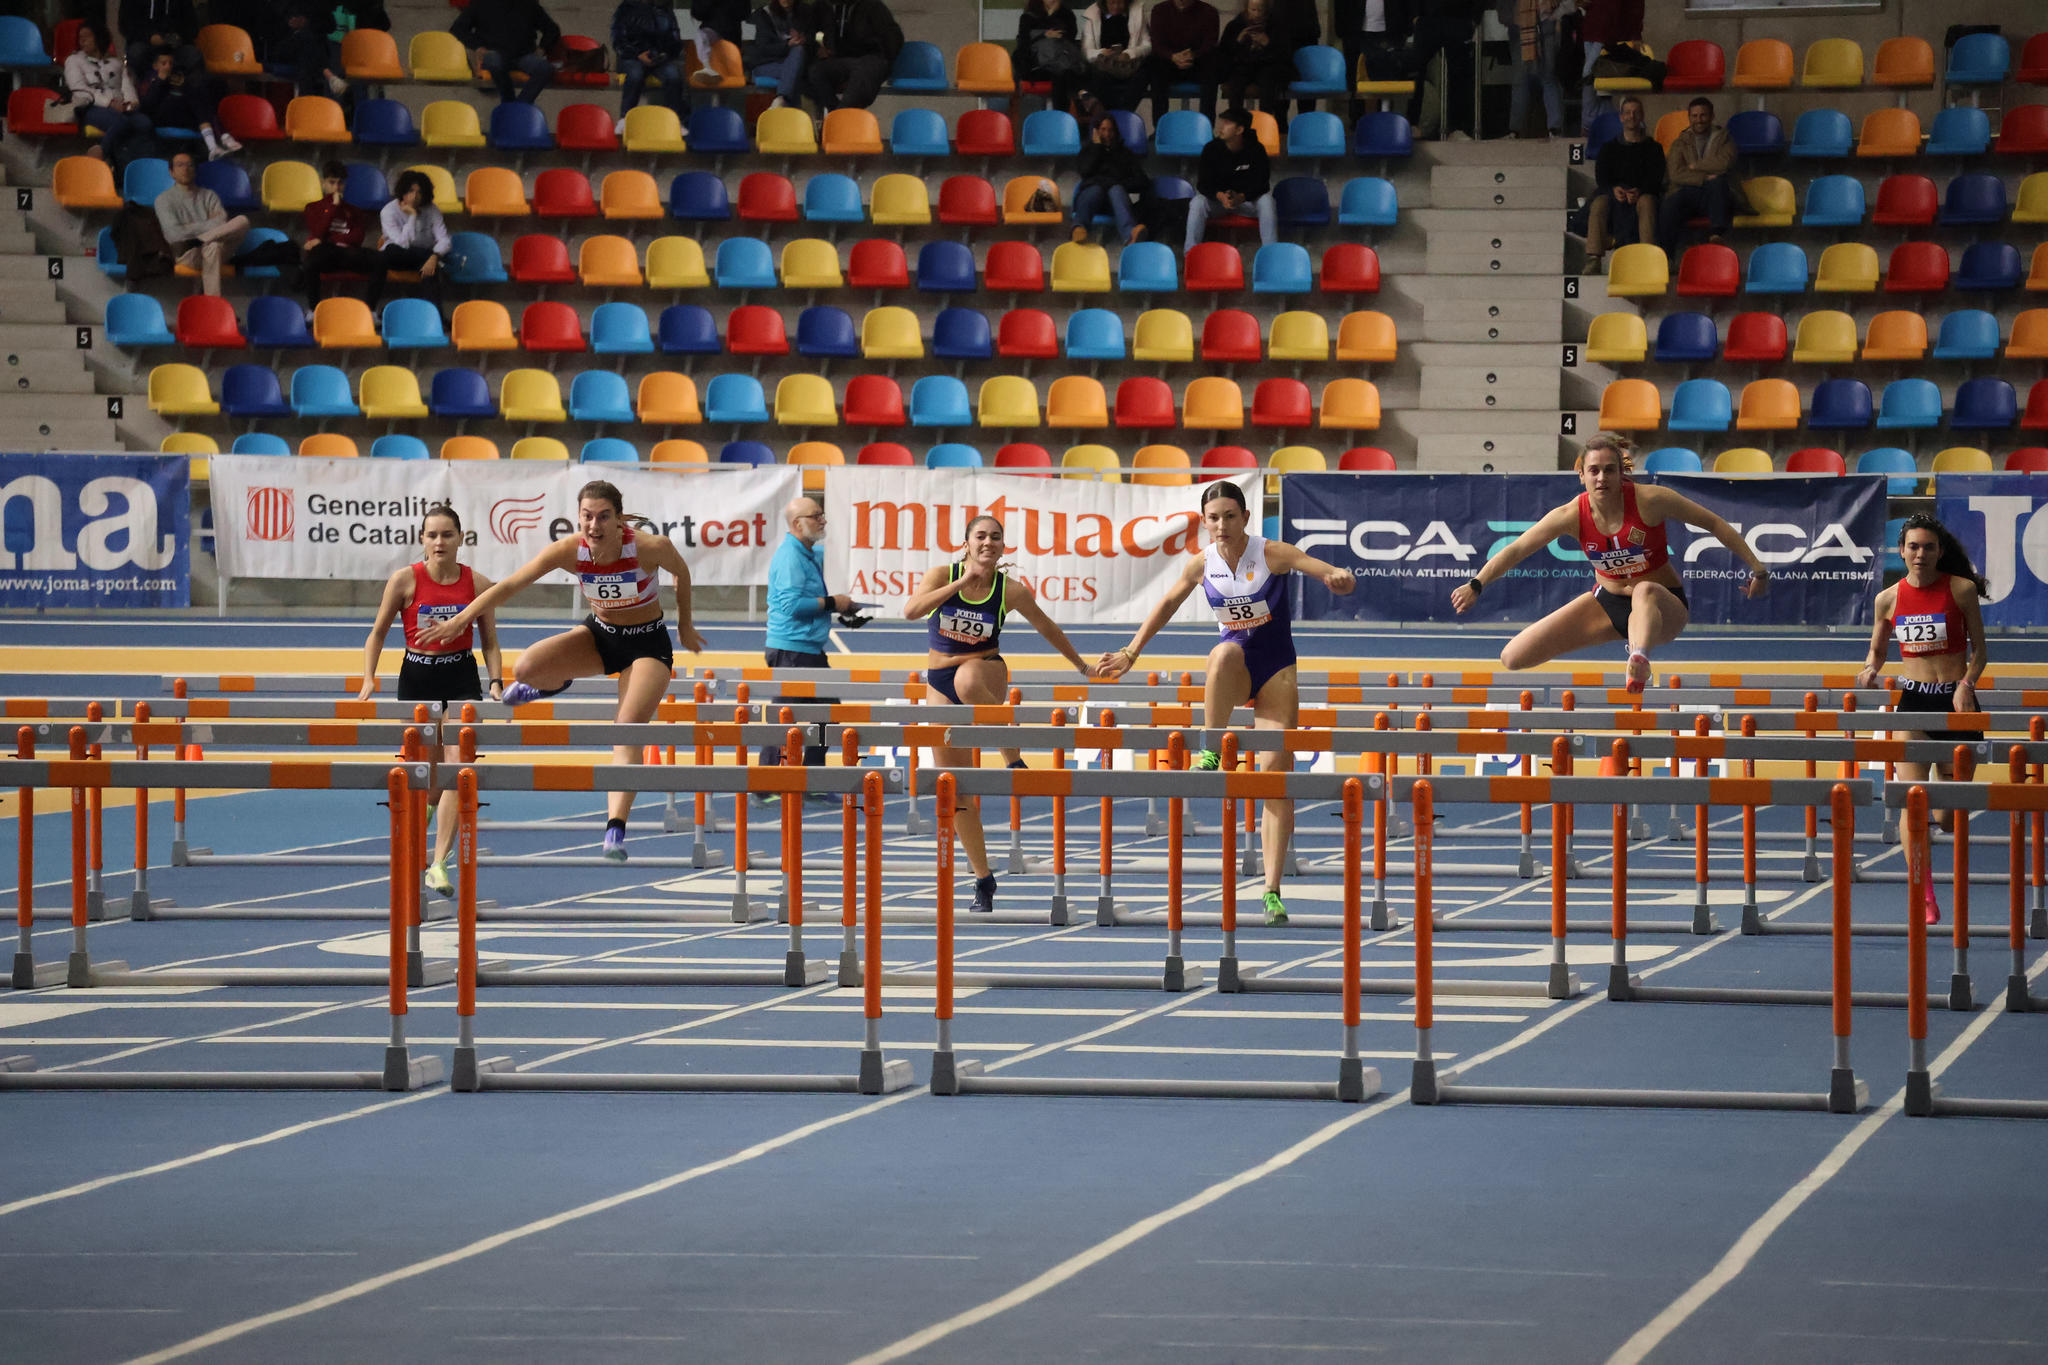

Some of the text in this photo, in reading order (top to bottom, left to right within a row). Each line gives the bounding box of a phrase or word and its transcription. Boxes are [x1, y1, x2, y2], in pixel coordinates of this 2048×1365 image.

[1572, 149, 1581, 161] 8
[20, 194, 29, 206] 7
[51, 263, 60, 275] 6
[1566, 282, 1576, 294] 6
[80, 332, 89, 344] 5
[1566, 351, 1574, 362] 5
[111, 402, 119, 413] 4
[1563, 418, 1573, 430] 4
[308, 522, 340, 544] de
[852, 495, 1214, 559] mutuaca
[1291, 519, 1477, 561] FCA
[1683, 523, 1875, 563] FCA
[1354, 567, 1413, 578] CATALANA
[1416, 567, 1478, 578] ATLETISME
[1682, 568, 1875, 580] FEDERACIÓ CTALANA ATLETISME
[598, 584, 622, 599] 63
[1229, 605, 1254, 620] 58
[622, 624, 654, 636] NIKE
[950, 618, 984, 637] 129
[1903, 625, 1937, 642] 123
[406, 652, 432, 665] NIKE
[435, 653, 463, 665] PRO
[1918, 682, 1953, 694] NIKE
